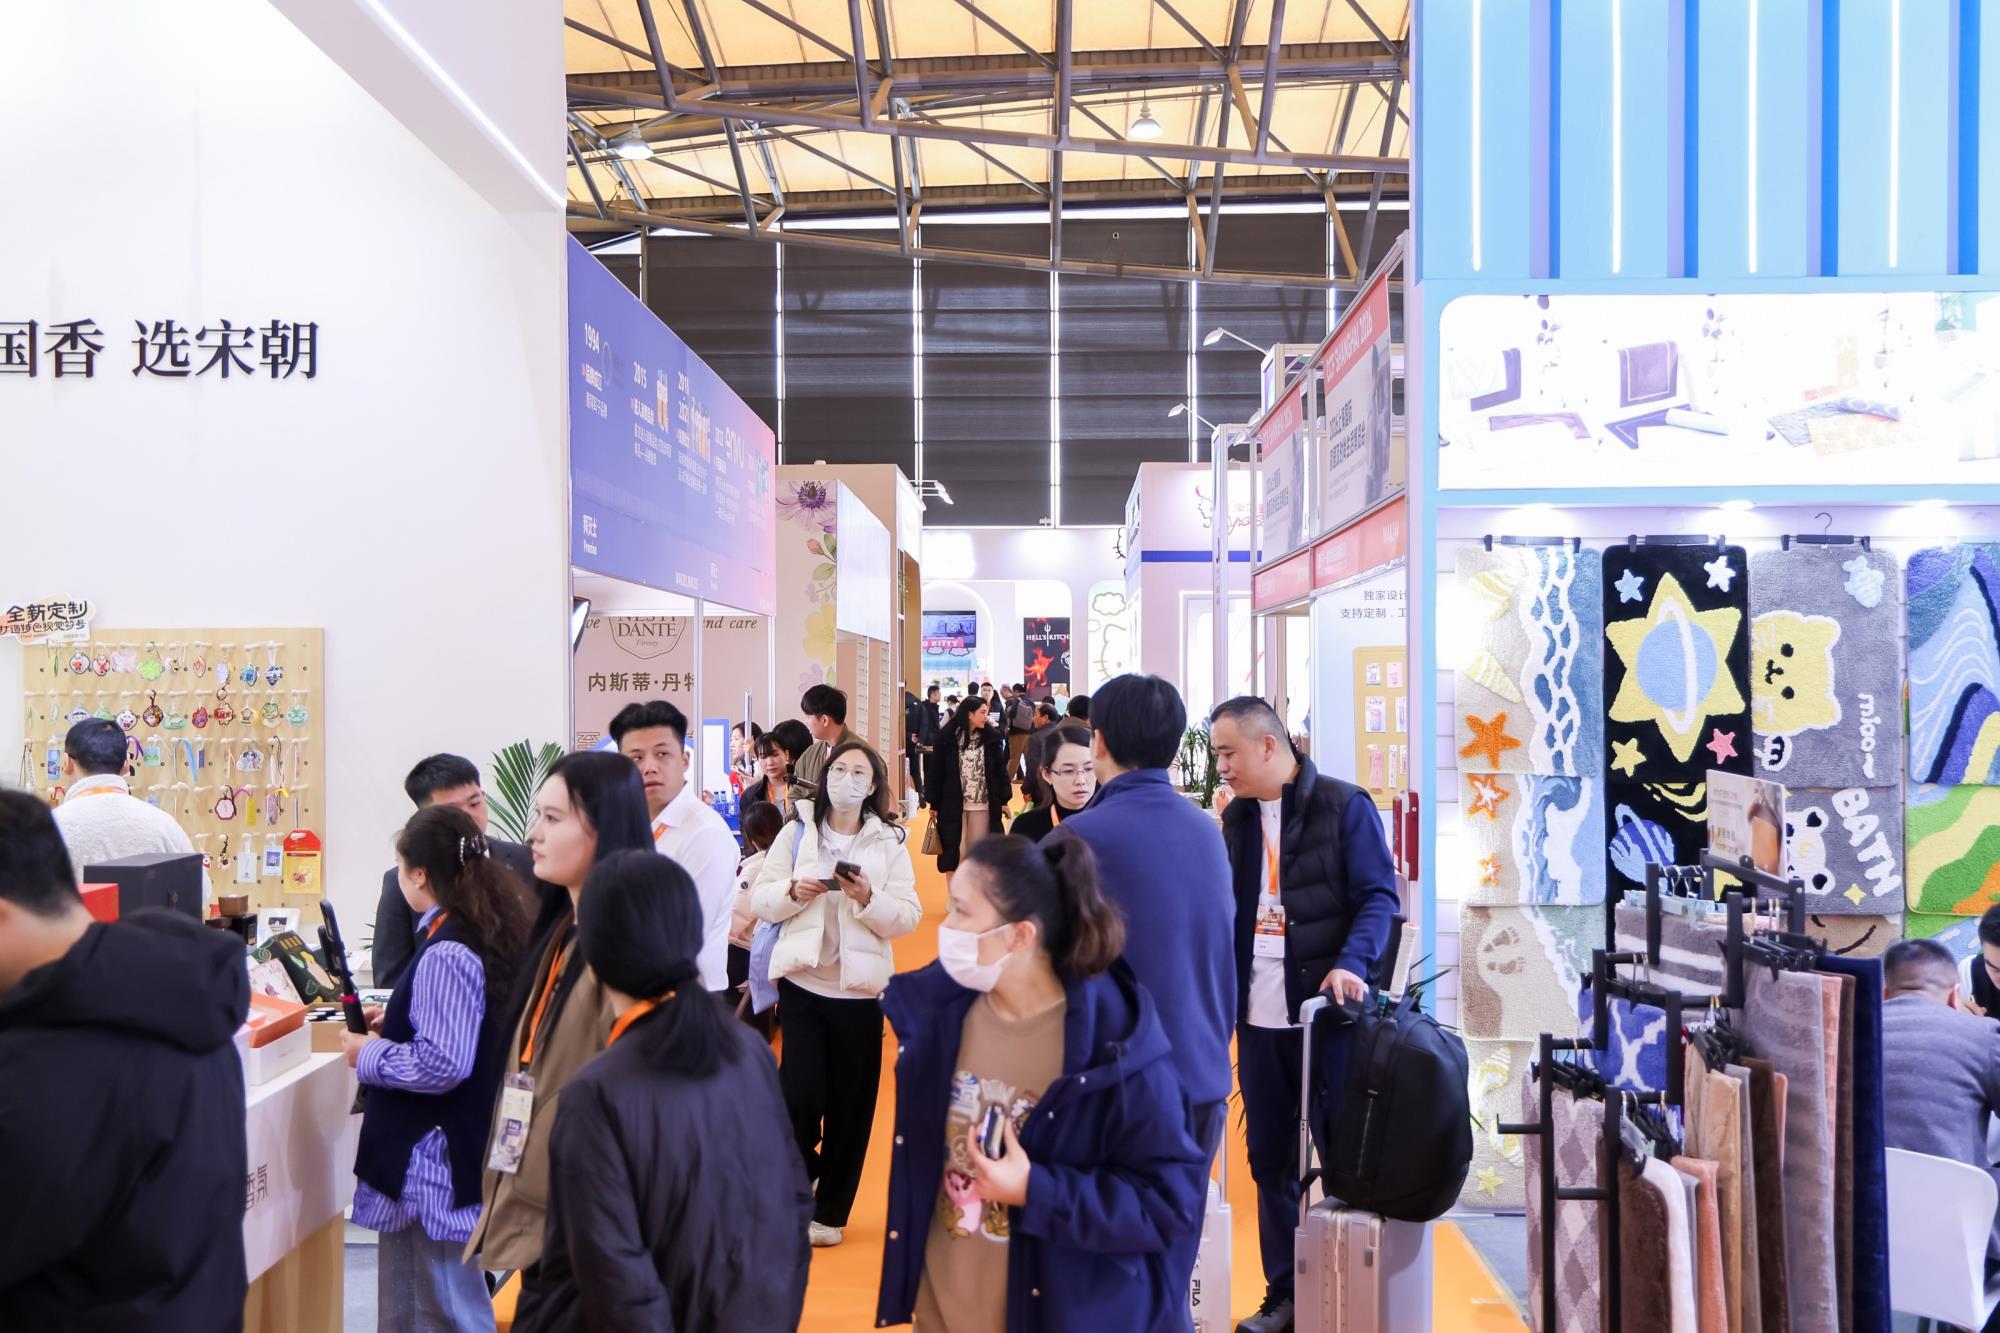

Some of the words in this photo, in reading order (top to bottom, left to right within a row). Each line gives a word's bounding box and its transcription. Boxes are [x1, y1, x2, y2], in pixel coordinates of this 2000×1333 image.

[0, 318, 105, 379] 国香
[131, 318, 319, 379] 选宋朝
[584, 323, 600, 354] 1994
[1334, 323, 1360, 374] SHANGHAI
[1359, 307, 1373, 345] 2026
[633, 361, 647, 390] 2015
[6, 600, 88, 624] 全新定制
[703, 617, 723, 629] nd
[729, 618, 757, 629] care
[617, 623, 677, 637] DANTE
[1832, 787, 1902, 898] BATH
[1192, 1279, 1201, 1307] FILA
